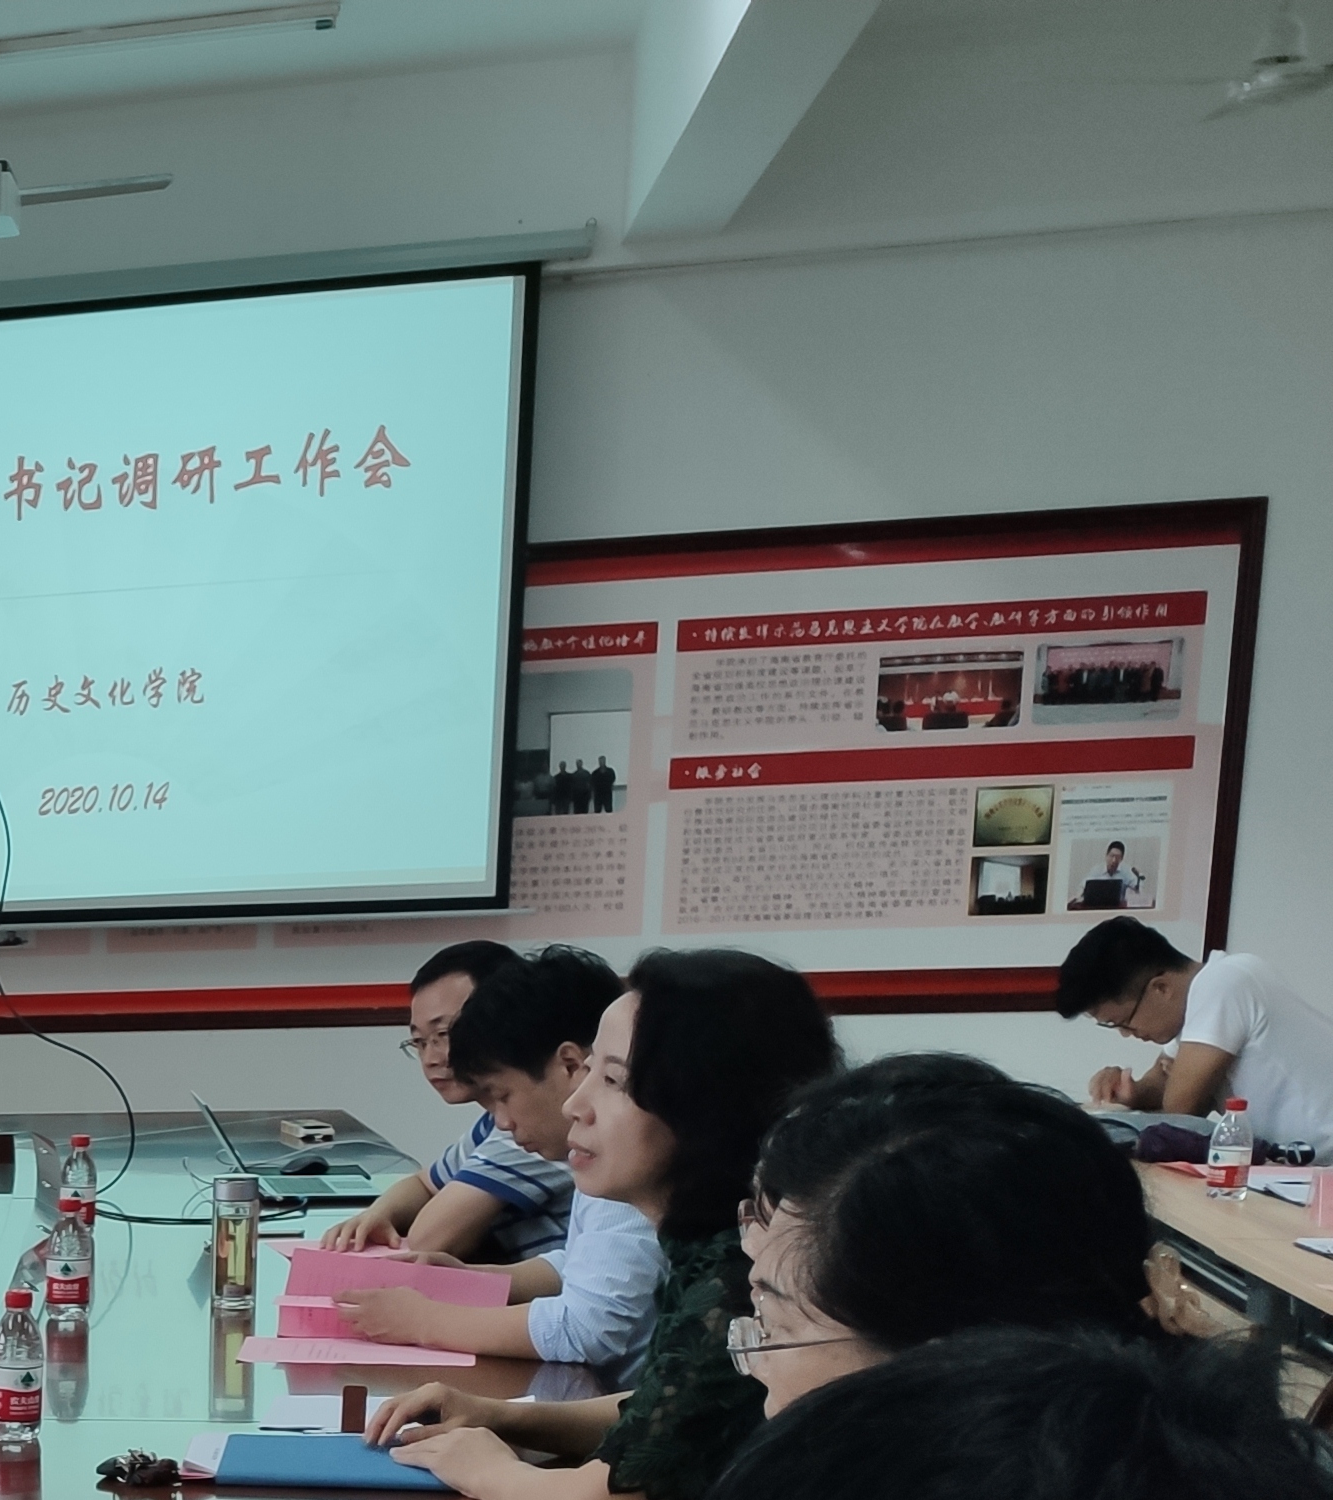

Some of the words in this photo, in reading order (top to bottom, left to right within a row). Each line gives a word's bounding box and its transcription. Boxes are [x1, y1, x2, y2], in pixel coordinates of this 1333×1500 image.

[6, 667, 205, 717] 历史文化学院
[38, 780, 170, 818] 2020.10.14
